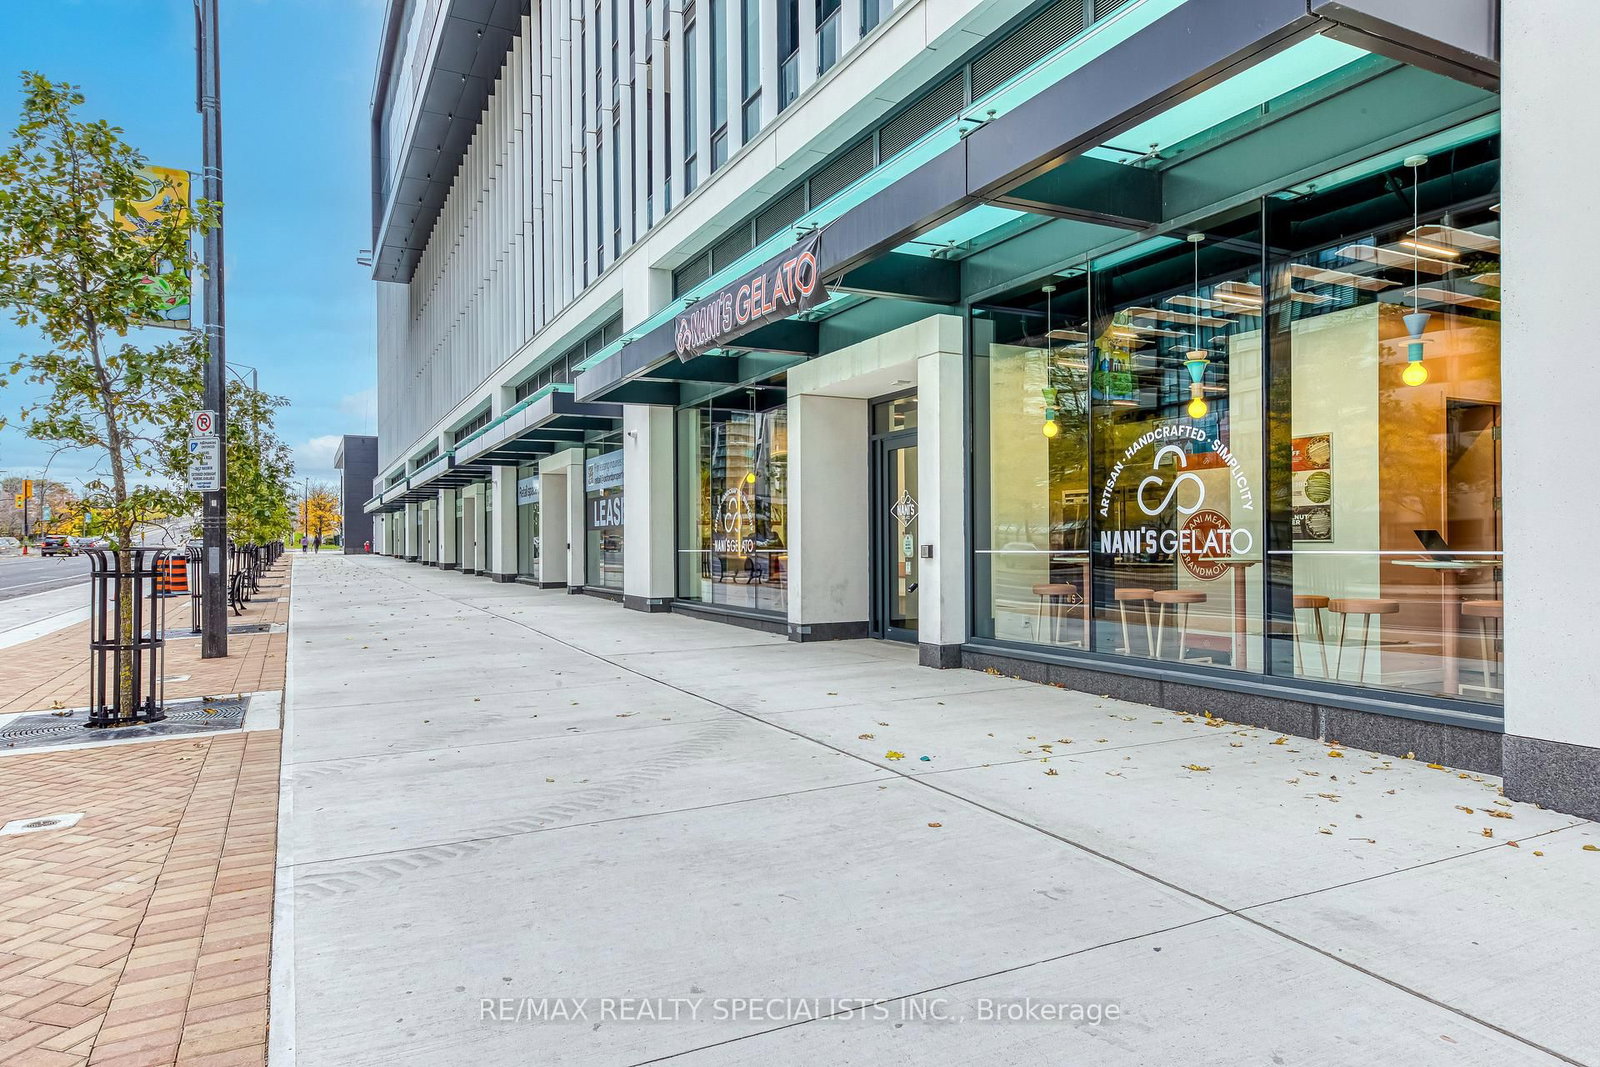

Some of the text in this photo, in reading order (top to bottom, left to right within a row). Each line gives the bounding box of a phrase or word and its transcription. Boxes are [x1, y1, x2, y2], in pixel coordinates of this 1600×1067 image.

[690, 251, 817, 349] NANI'S GELATO
[1100, 425, 1253, 517] ARTISAN HANDCRAFTED SIMPLICITY
[1100, 527, 1253, 554] NANI'S GELATO
